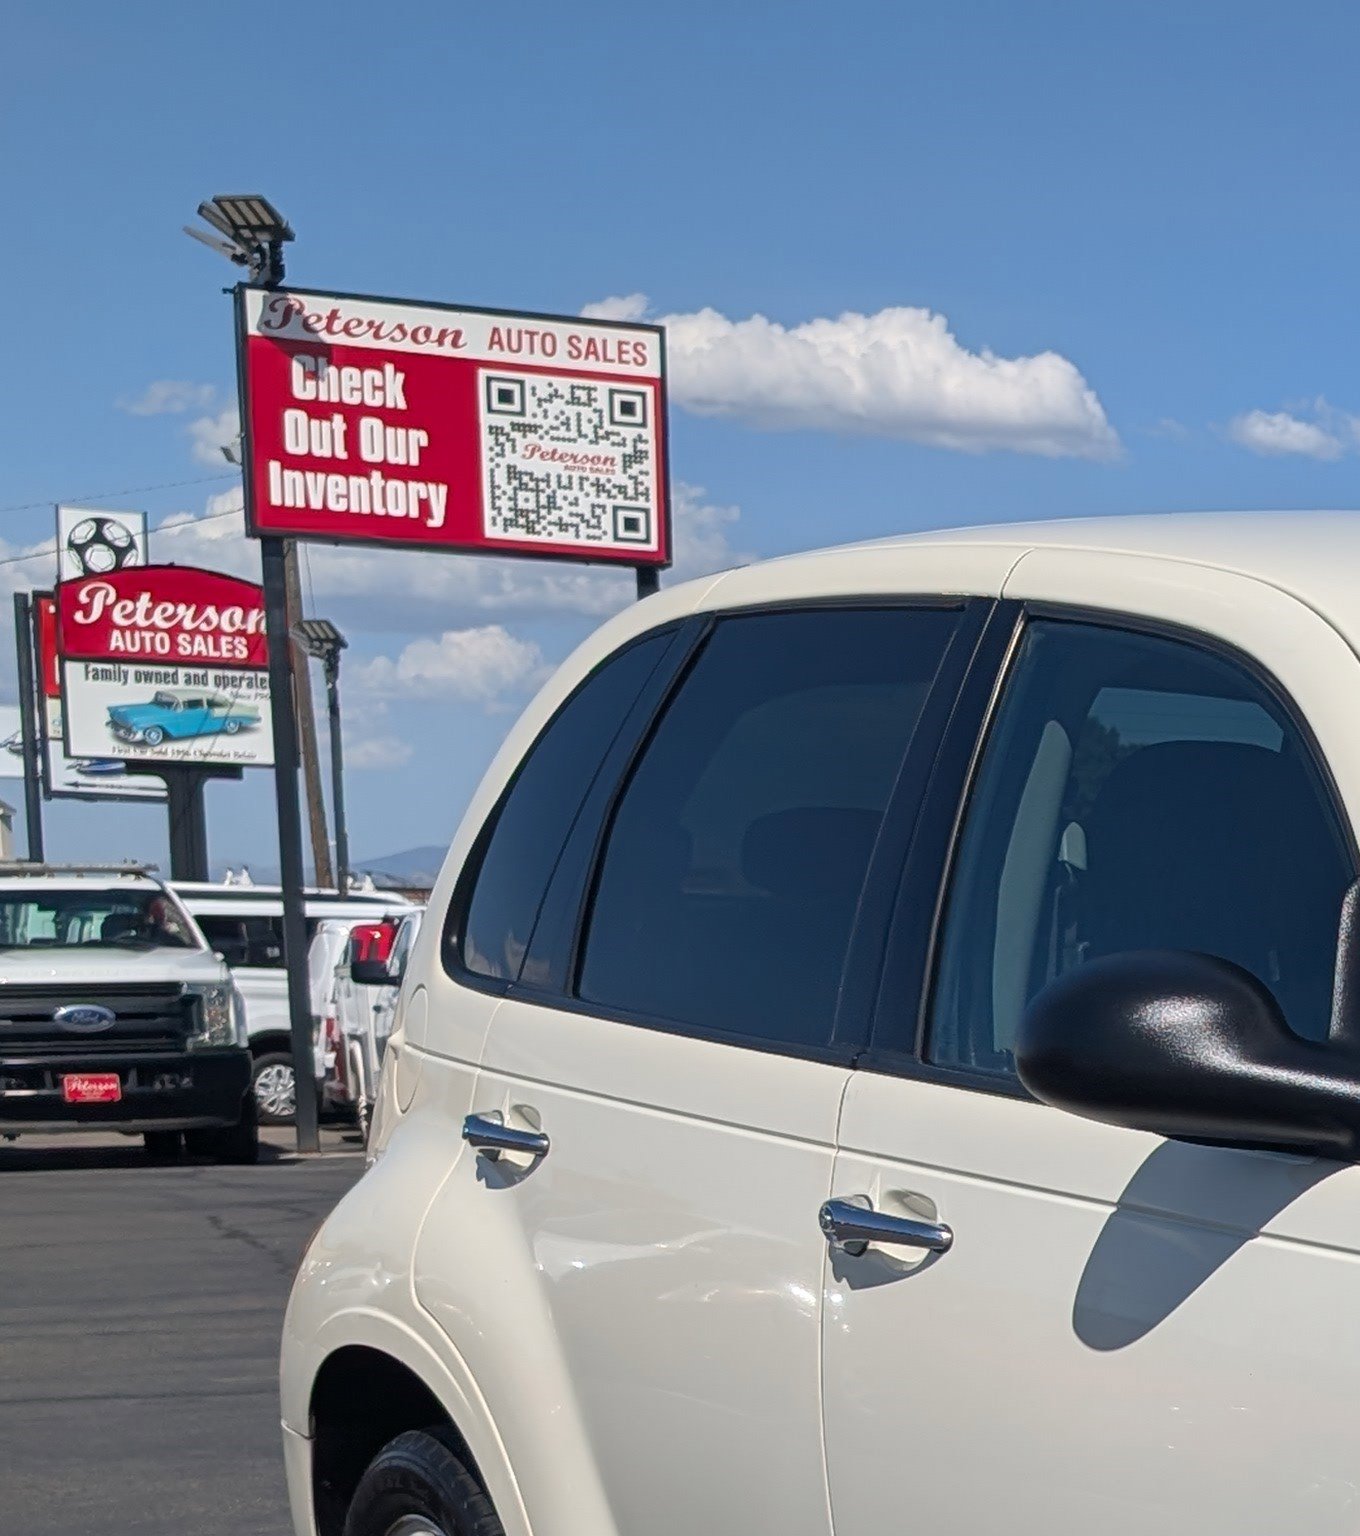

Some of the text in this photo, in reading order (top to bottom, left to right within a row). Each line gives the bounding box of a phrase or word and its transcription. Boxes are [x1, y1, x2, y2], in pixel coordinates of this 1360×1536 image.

[263, 296, 648, 367] Peterson AUTO SALES
[291, 354, 408, 410] Check
[284, 408, 429, 466] Out Our
[521, 442, 618, 467] Peterson
[268, 459, 448, 528] Inventory
[73, 581, 267, 635] Peterson
[109, 629, 249, 660] AUTO SALES
[84, 663, 269, 690] Family owned and operate
